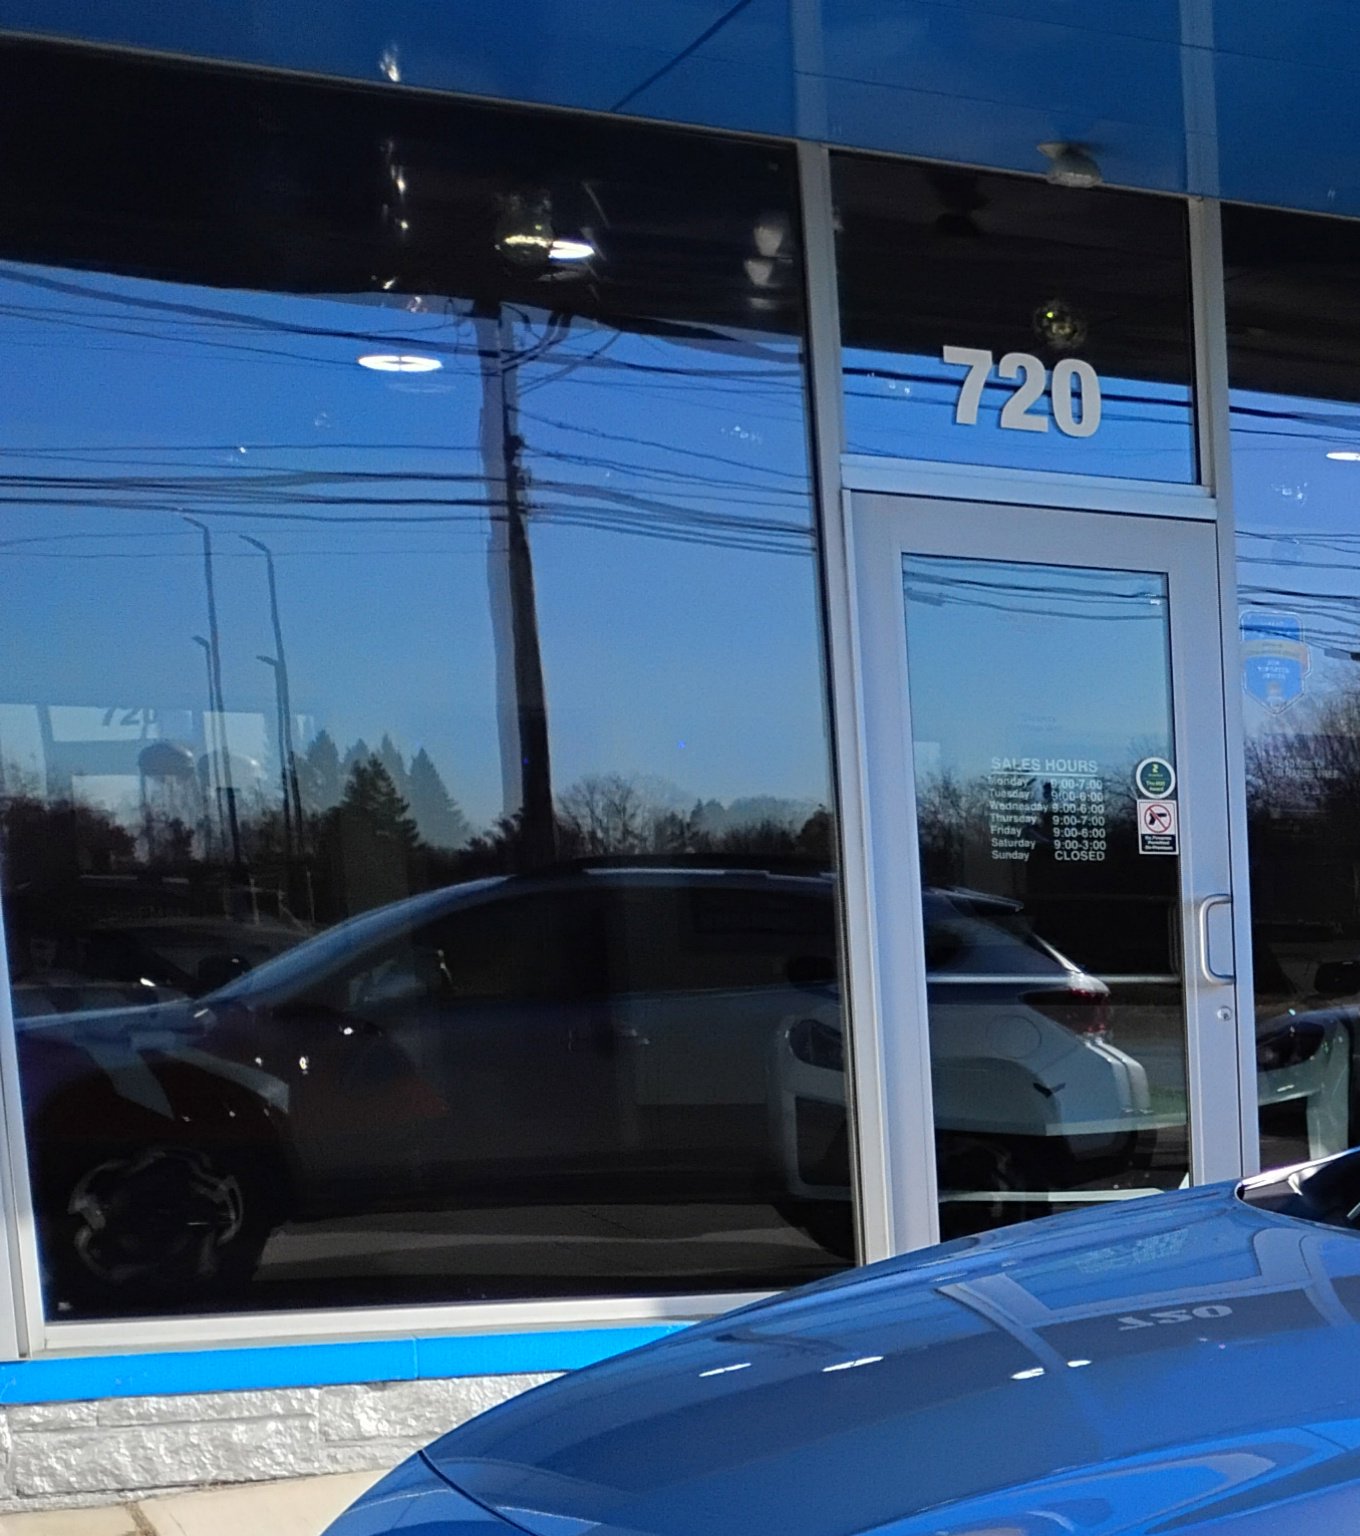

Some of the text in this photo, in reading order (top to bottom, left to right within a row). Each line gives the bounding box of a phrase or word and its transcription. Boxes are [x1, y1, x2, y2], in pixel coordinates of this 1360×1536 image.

[943, 345, 1101, 438] 720
[991, 757, 1098, 773] SALES HOURS
[988, 776, 1029, 787] Monday
[990, 788, 1030, 800] Tuesday
[989, 800, 1105, 814] Wednesday 9:00-6:00
[990, 813, 1105, 826] Thursday 9:00-7:00
[991, 825, 1106, 838] Friday 9:00-6:00
[991, 838, 1107, 850] Saturday 9:00-3:00
[992, 850, 1105, 862] Sunday CLOSED
